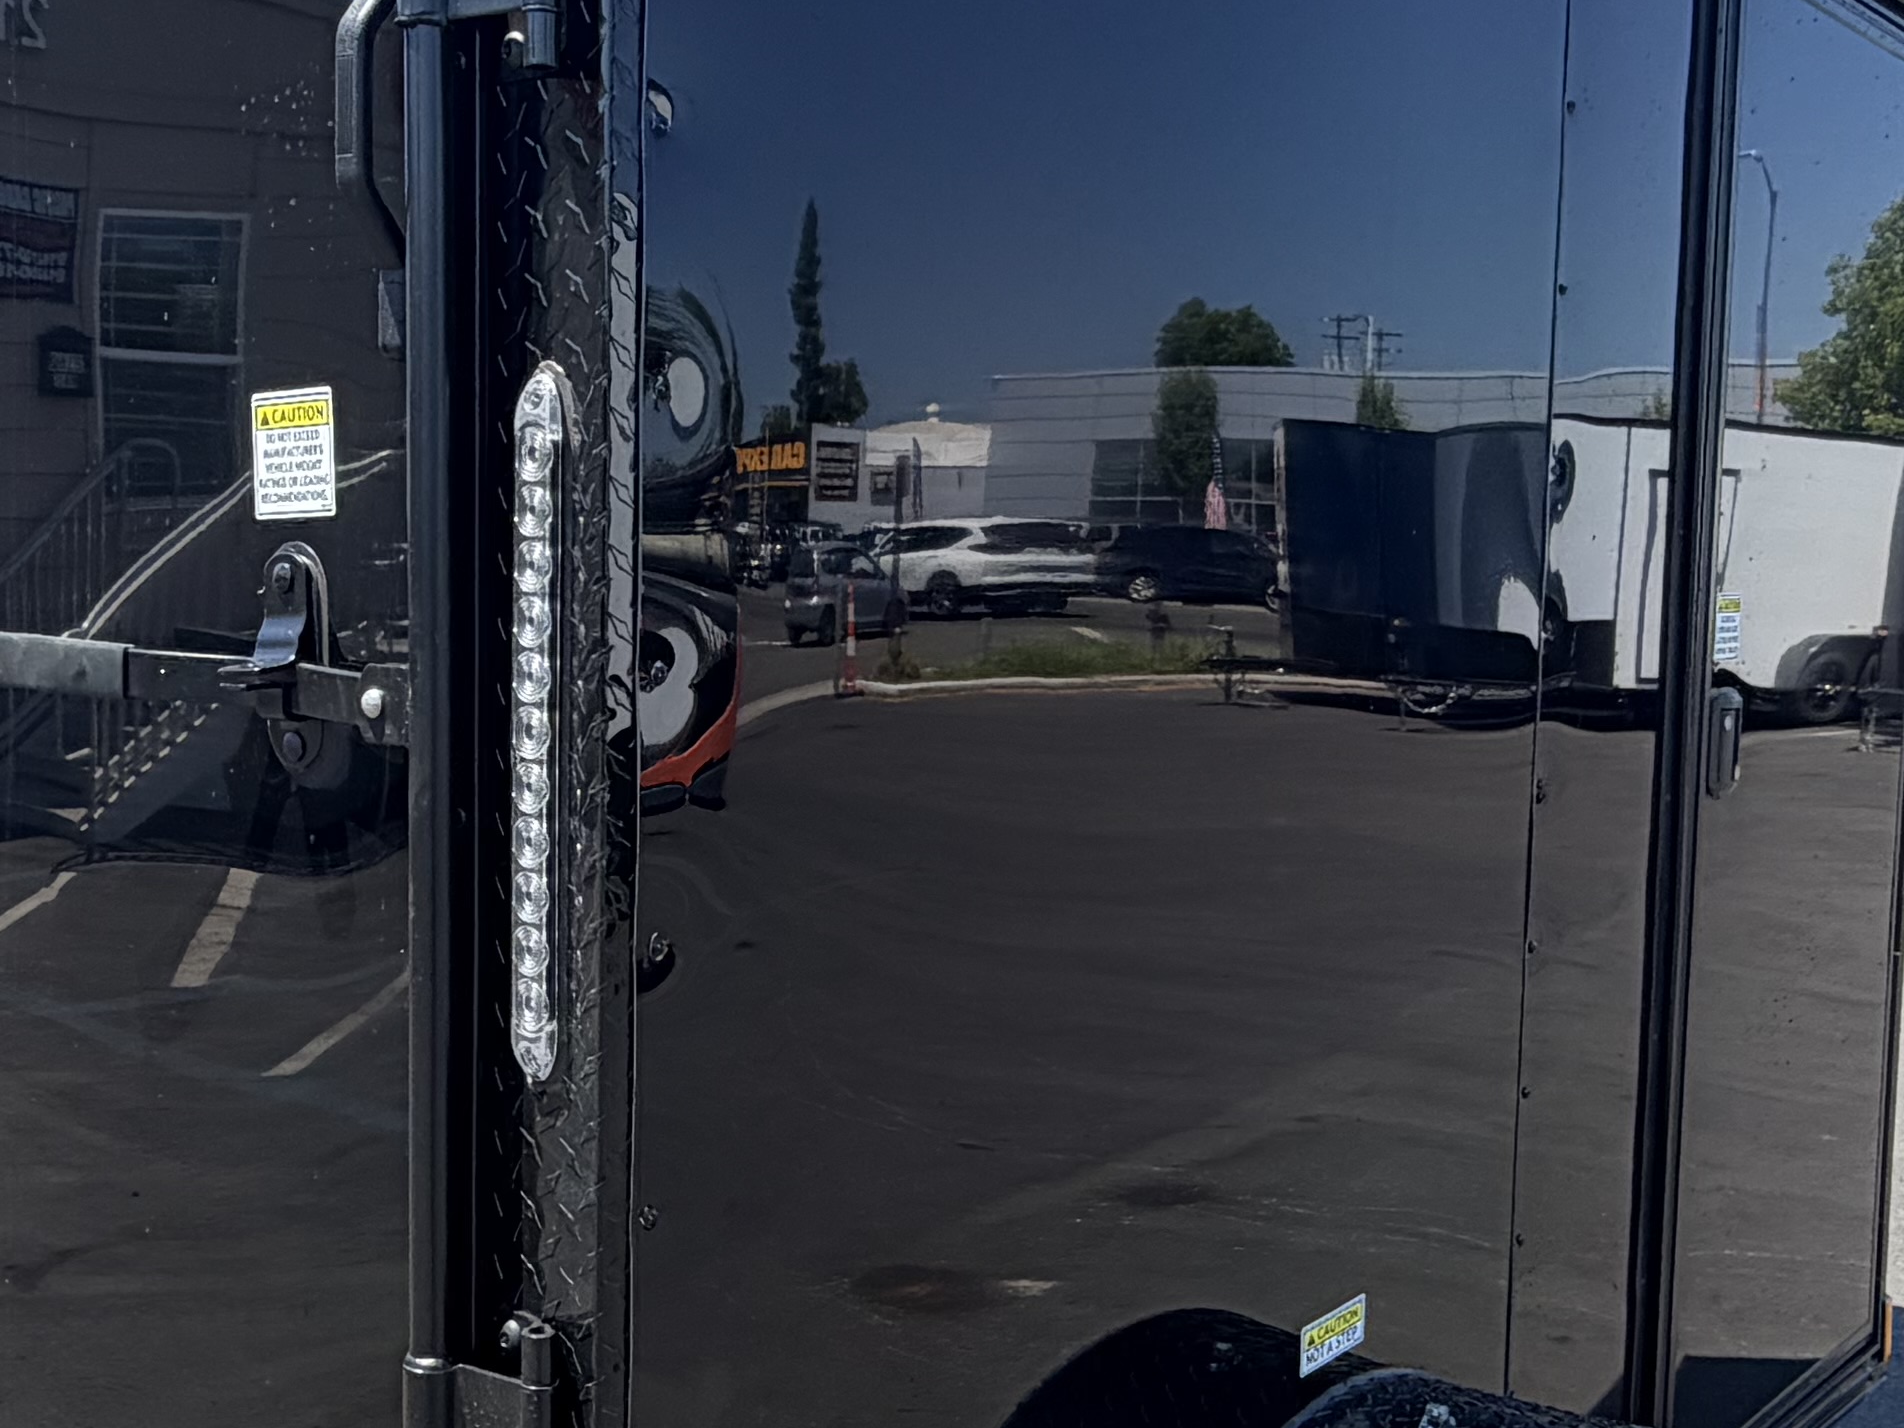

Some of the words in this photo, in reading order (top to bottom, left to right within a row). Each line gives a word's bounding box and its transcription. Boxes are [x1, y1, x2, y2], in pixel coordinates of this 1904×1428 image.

[271, 405, 324, 424] CAUTION
[1317, 1308, 1359, 1340] CAUTION
[1305, 1343, 1325, 1366] NOT
[1335, 1326, 1358, 1349] STEP
